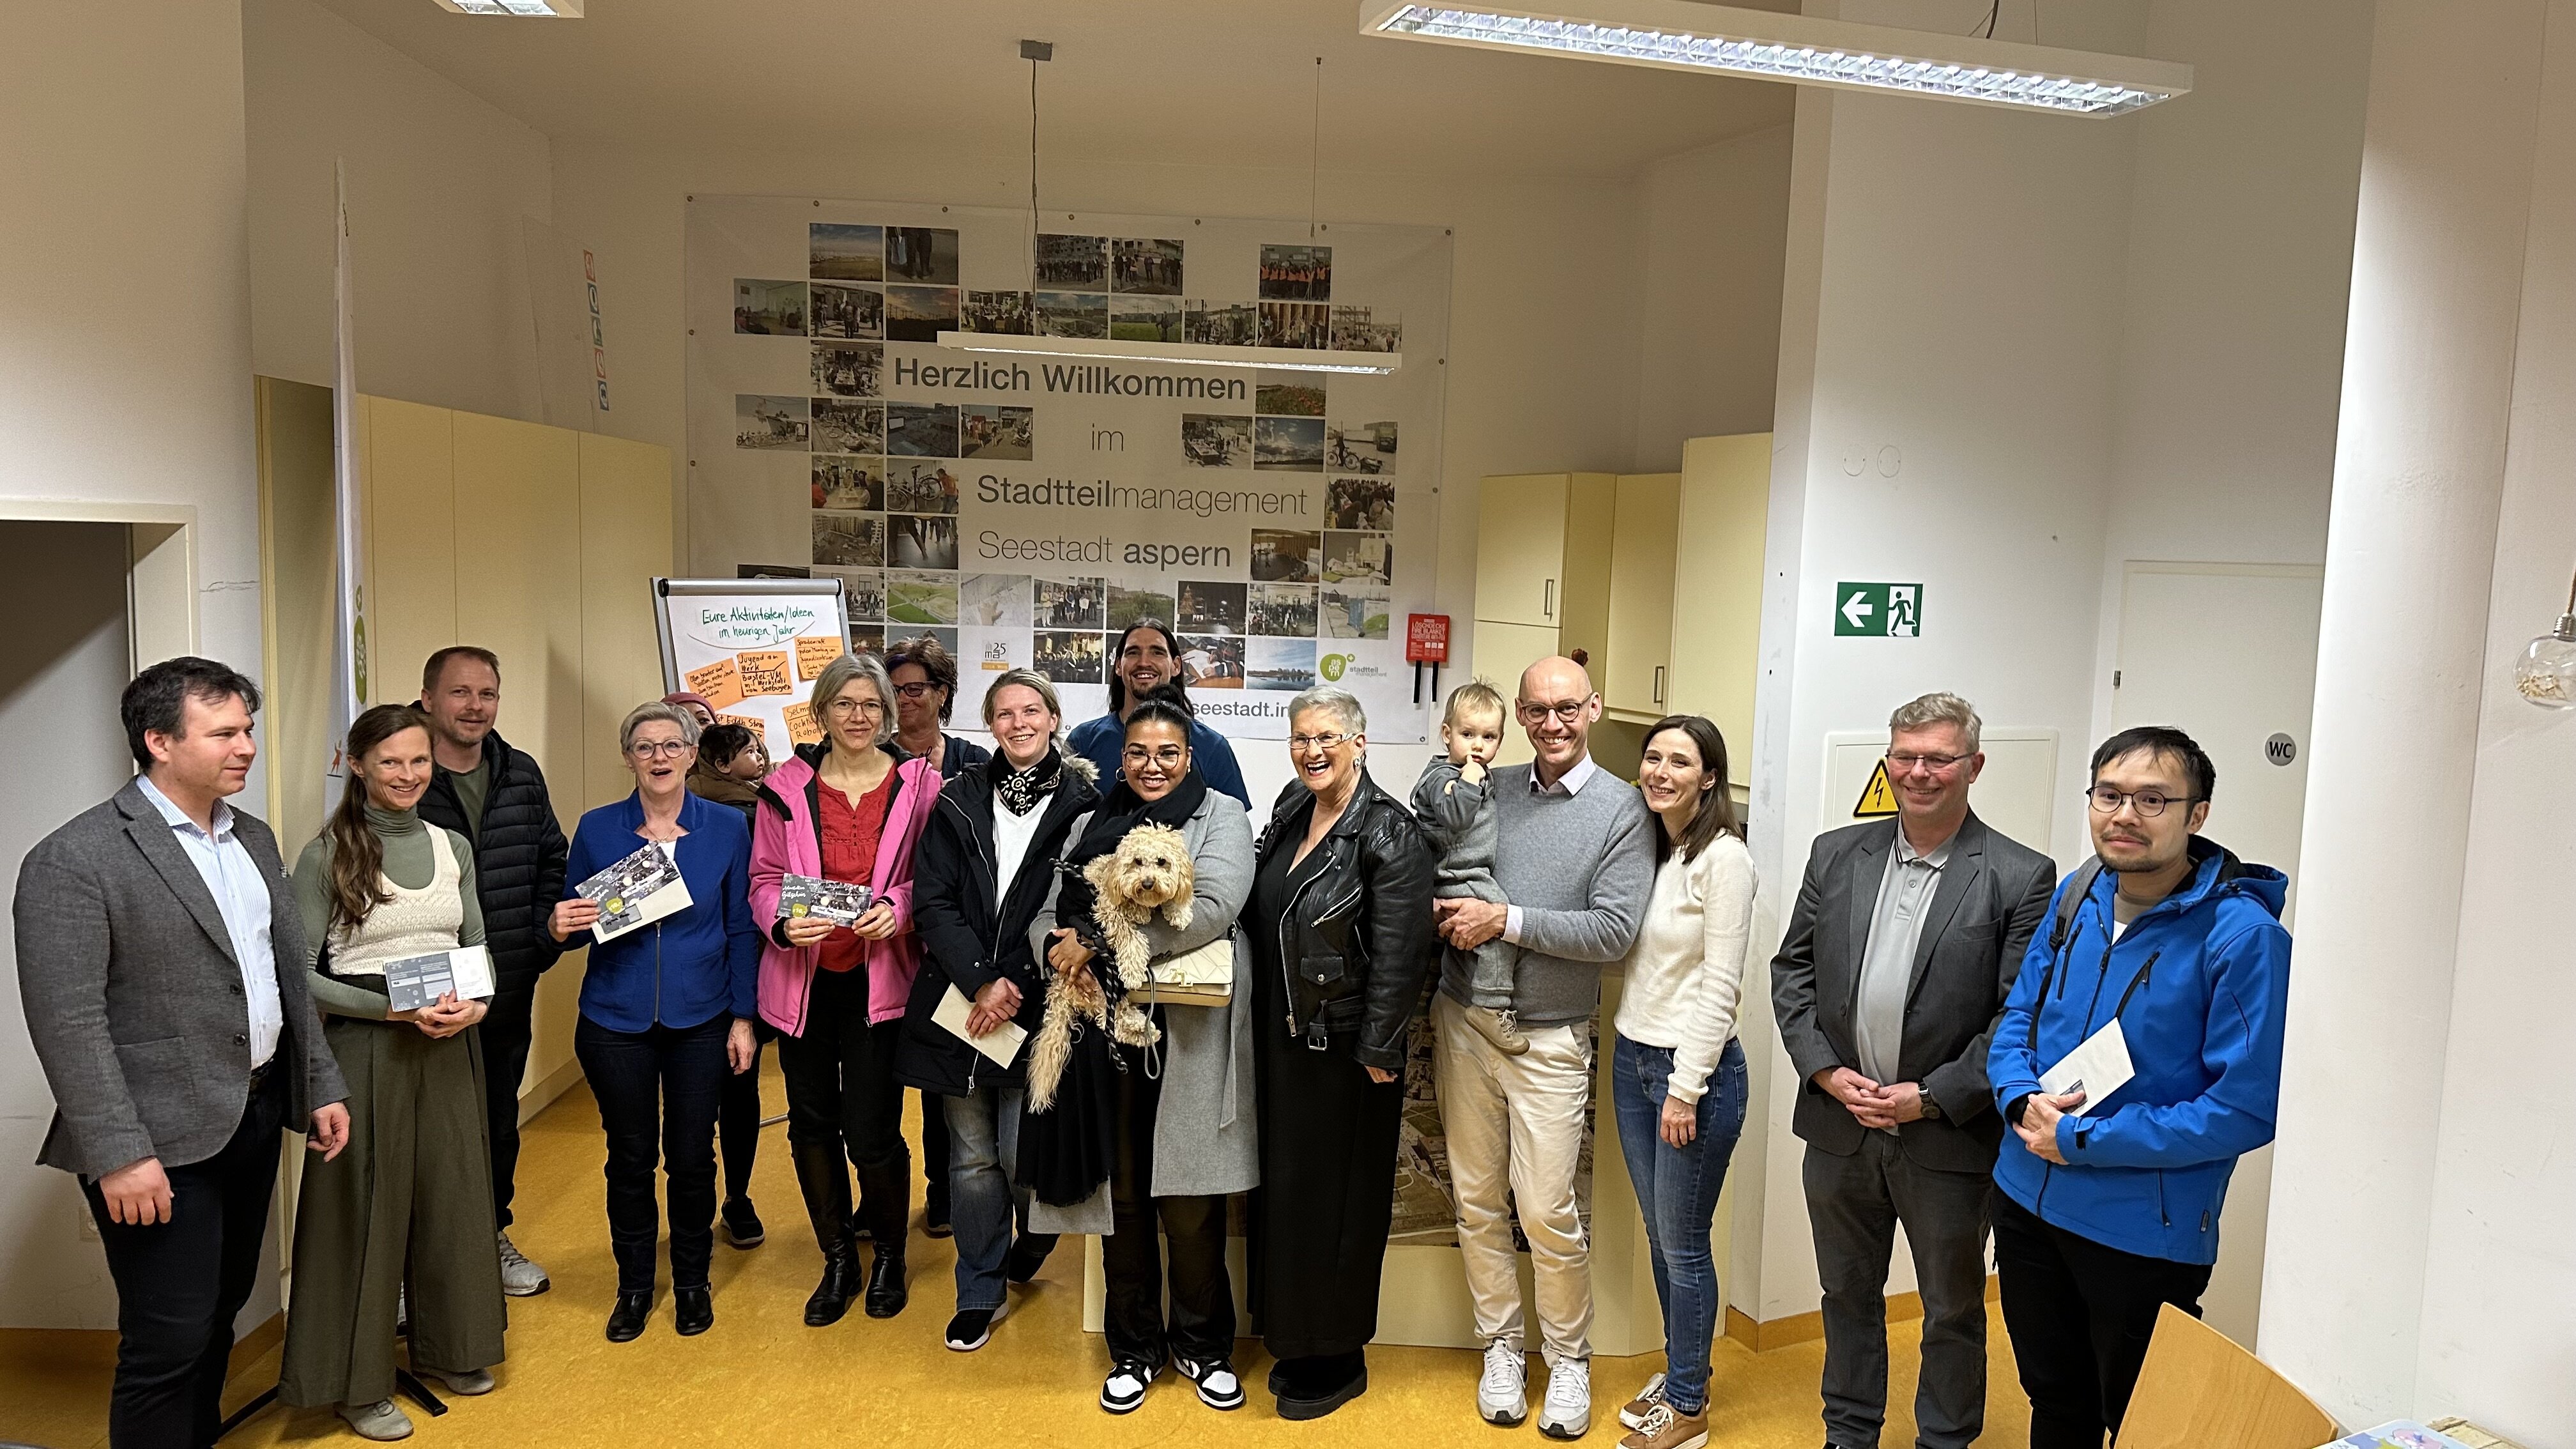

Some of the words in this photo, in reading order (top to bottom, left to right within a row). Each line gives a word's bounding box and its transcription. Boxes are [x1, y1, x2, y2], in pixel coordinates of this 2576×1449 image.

[895, 357, 1030, 391] Herzlich
[1041, 364, 1246, 401] Willkommen
[1091, 423, 1124, 452] im
[977, 475, 1308, 518] Stadtteilmanagement
[978, 531, 1114, 564] Seestadt
[1123, 540, 1230, 568] aspern
[702, 609, 728, 625] Eure
[719, 626, 730, 639] im
[732, 625, 770, 641] heurigen
[772, 624, 796, 645] Jahr
[739, 654, 764, 666] Jugend
[741, 663, 760, 672] Werk
[1193, 702, 1289, 717] seestadt.in
[2269, 741, 2292, 758] WC
